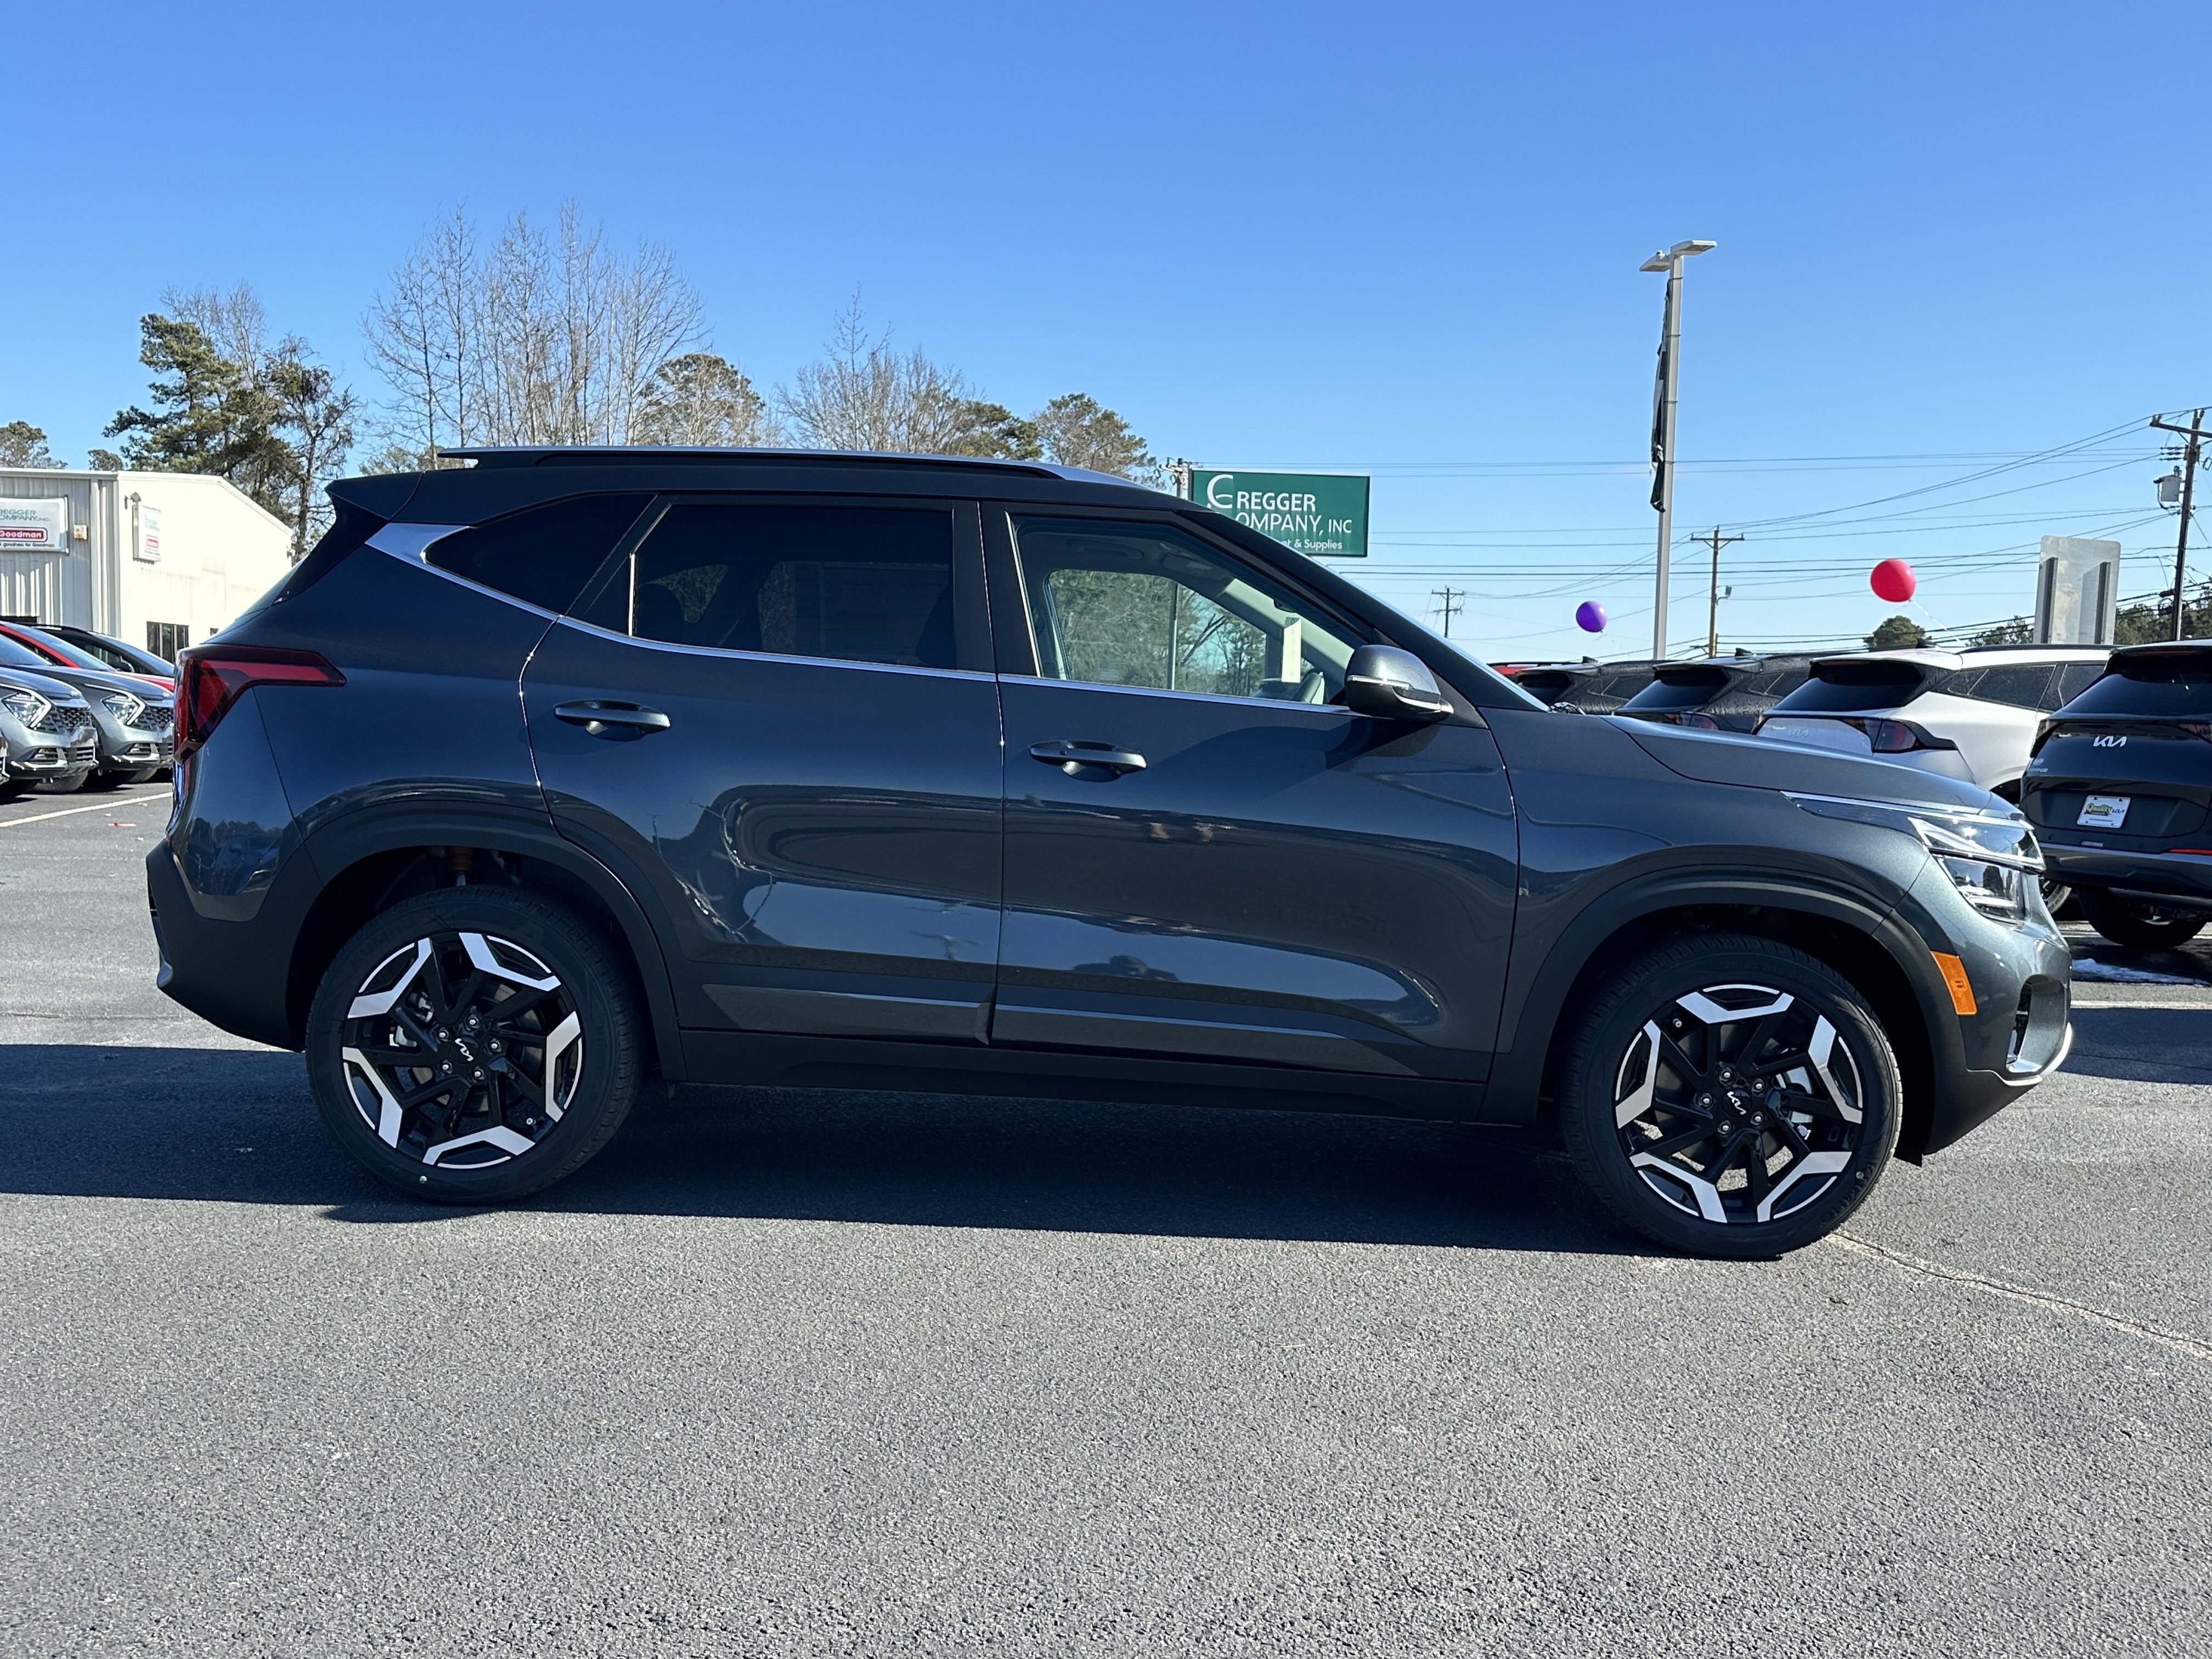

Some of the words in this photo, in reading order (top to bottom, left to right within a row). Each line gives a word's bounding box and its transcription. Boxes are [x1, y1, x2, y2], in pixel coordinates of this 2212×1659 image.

[1328, 519, 1352, 534] INC
[1294, 538, 1302, 548] &
[1304, 538, 1342, 552] Supplies
[2093, 735, 2128, 747] KIA
[455, 1038, 474, 1062] KIA
[1727, 1091, 1747, 1115] KIA
